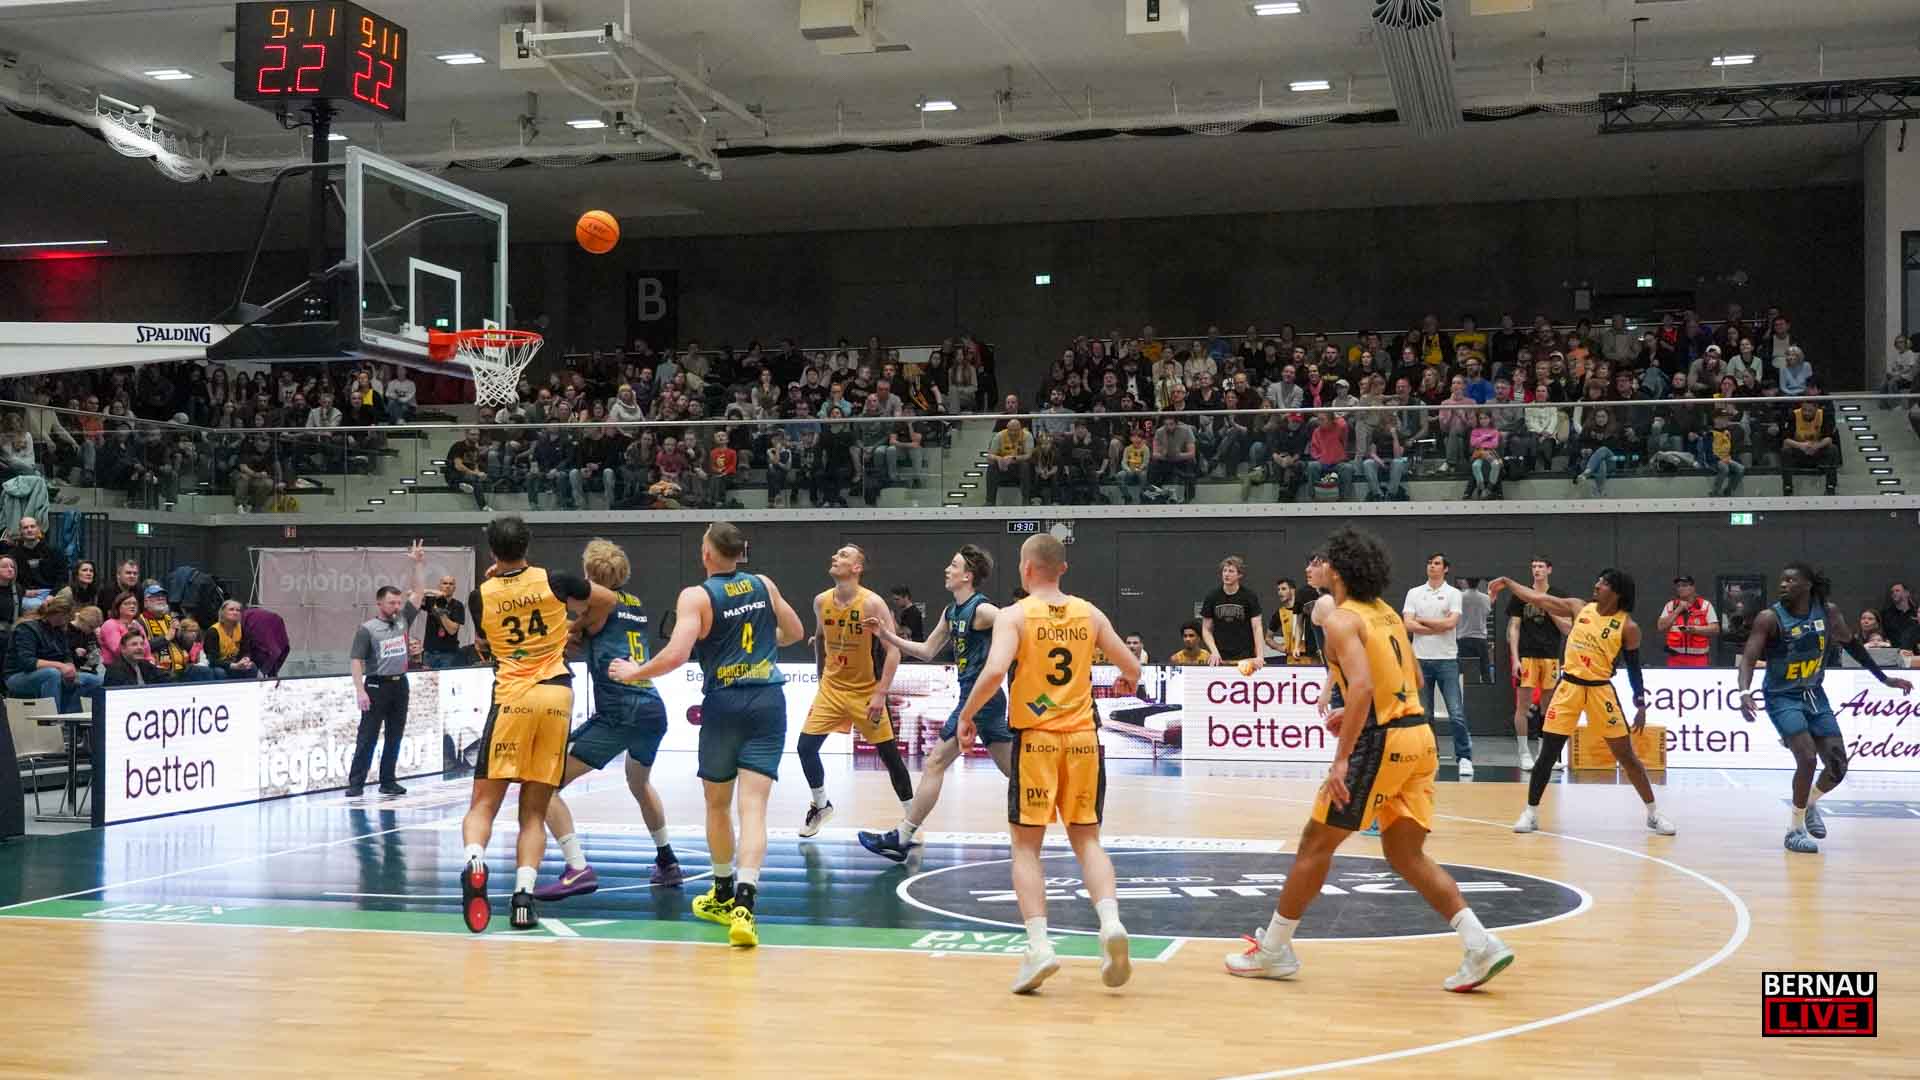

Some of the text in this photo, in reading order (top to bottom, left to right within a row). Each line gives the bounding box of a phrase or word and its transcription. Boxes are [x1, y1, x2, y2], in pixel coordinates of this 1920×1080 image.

[258, 44, 326, 93] 2.2
[638, 277, 667, 321] B
[136, 325, 211, 344] SPALDING
[1012, 522, 1034, 532] 19:30
[495, 593, 545, 615] JONAH
[502, 608, 549, 645] 34
[741, 622, 753, 654] 4
[848, 622, 863, 635] 15
[1601, 627, 1610, 639] 8
[626, 630, 645, 664] 15
[1046, 647, 1073, 687] 3
[1207, 673, 1321, 713] capric
[1604, 701, 1613, 713] 8
[126, 696, 230, 749] caprice
[1207, 715, 1325, 749] betten
[1666, 723, 1749, 752] etten
[126, 755, 215, 800] betten
